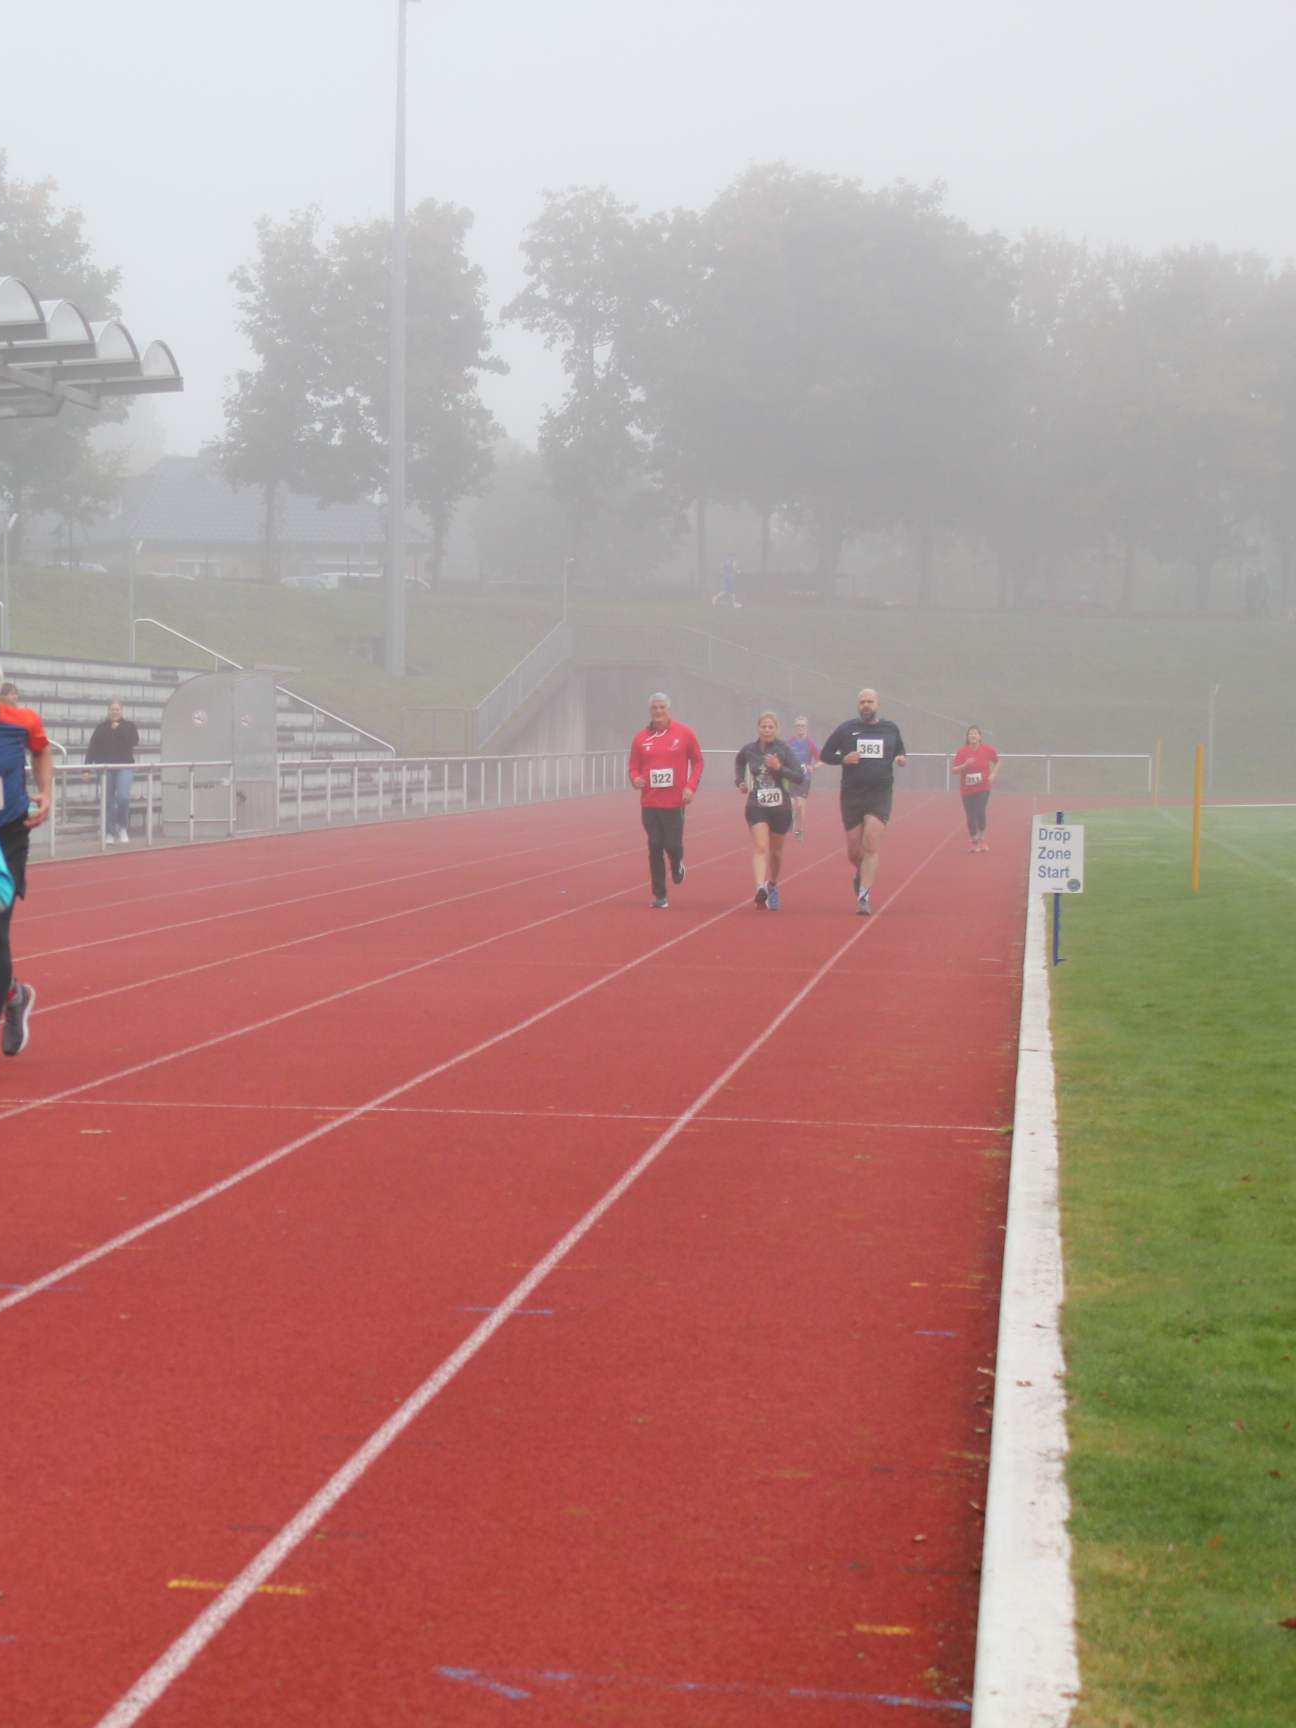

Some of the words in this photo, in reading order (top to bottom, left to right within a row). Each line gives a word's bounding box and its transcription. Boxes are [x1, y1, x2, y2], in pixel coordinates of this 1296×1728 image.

[860, 744, 880, 755] 363
[652, 773, 672, 784] 322
[759, 792, 780, 803] 320
[1038, 827, 1072, 844] Drop
[1038, 847, 1072, 860] Zone
[1038, 865, 1070, 879] Start
